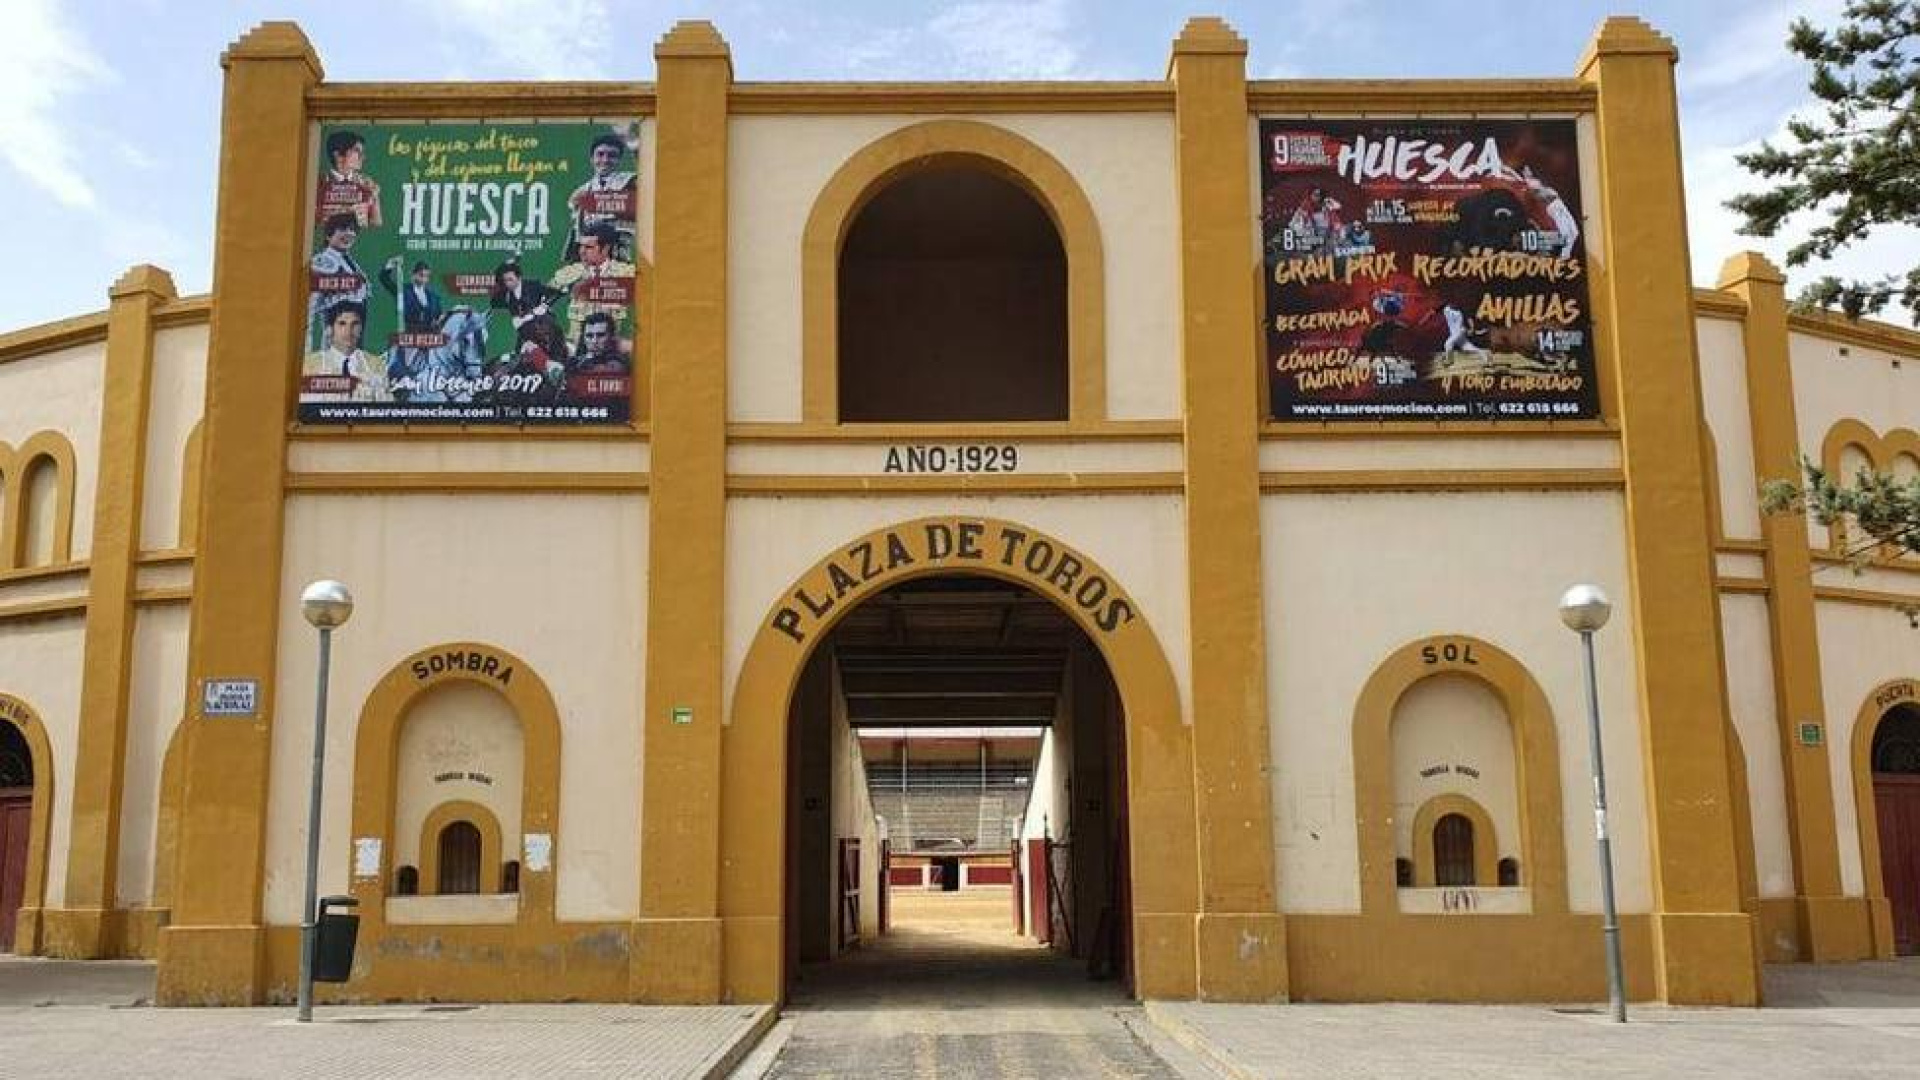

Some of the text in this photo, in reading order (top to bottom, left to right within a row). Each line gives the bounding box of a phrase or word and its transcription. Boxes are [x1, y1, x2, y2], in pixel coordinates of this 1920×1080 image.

[474, 128, 497, 150] del
[1274, 135, 1288, 165] 9
[424, 154, 446, 176] del
[507, 151, 554, 183] llegan
[1338, 135, 1502, 185] HUESCA
[399, 182, 549, 235] HUESCA
[1284, 229, 1294, 250] 8
[1520, 230, 1537, 250] 10
[1275, 251, 1582, 285] GRAN PRIX RECORTADORES
[1276, 308, 1371, 332] BECERRADA
[1376, 361, 1387, 385] 9
[1458, 374, 1494, 394] TORO
[1500, 375, 1583, 391] EMBOLADO
[319, 405, 495, 418] www.tauroemocion.com
[1292, 402, 1467, 414] www.tauroemocion.com
[772, 522, 1135, 644] PLAZA DE TOROS
[1421, 643, 1479, 665] SOL
[412, 650, 513, 685] SOMBRA
